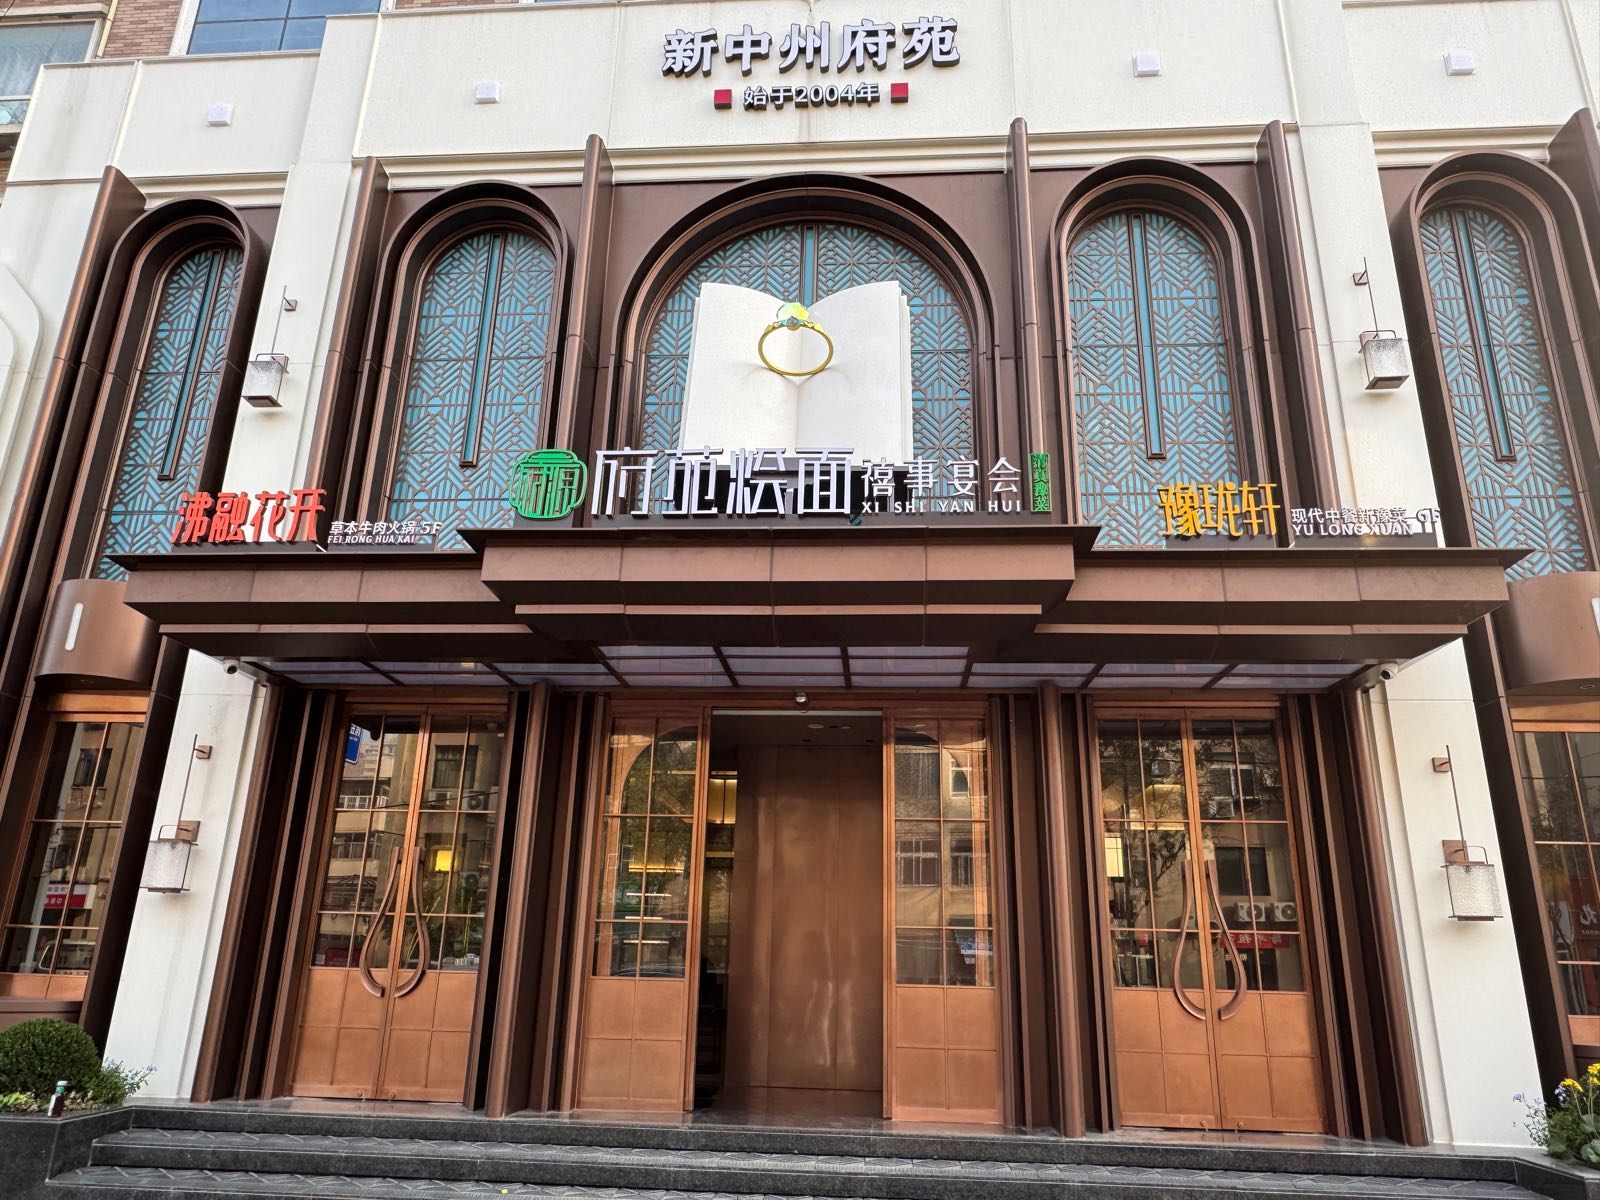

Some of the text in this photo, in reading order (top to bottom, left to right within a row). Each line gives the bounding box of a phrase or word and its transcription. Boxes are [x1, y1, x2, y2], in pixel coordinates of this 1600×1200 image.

[661, 16, 960, 77] 新中州府苑
[743, 82, 881, 110] 始于2004年
[861, 455, 1022, 498] 禧事宴会
[171, 488, 328, 545] 沸融花开
[861, 499, 1021, 514] XI SHI YAN HUI
[1156, 479, 1281, 538] 豫珑轩
[327, 535, 415, 544] FEI RONG HUA KAI
[328, 520, 443, 535] 草本牛肉火锅 5F
[1292, 523, 1415, 536] YU LONG XUAN
